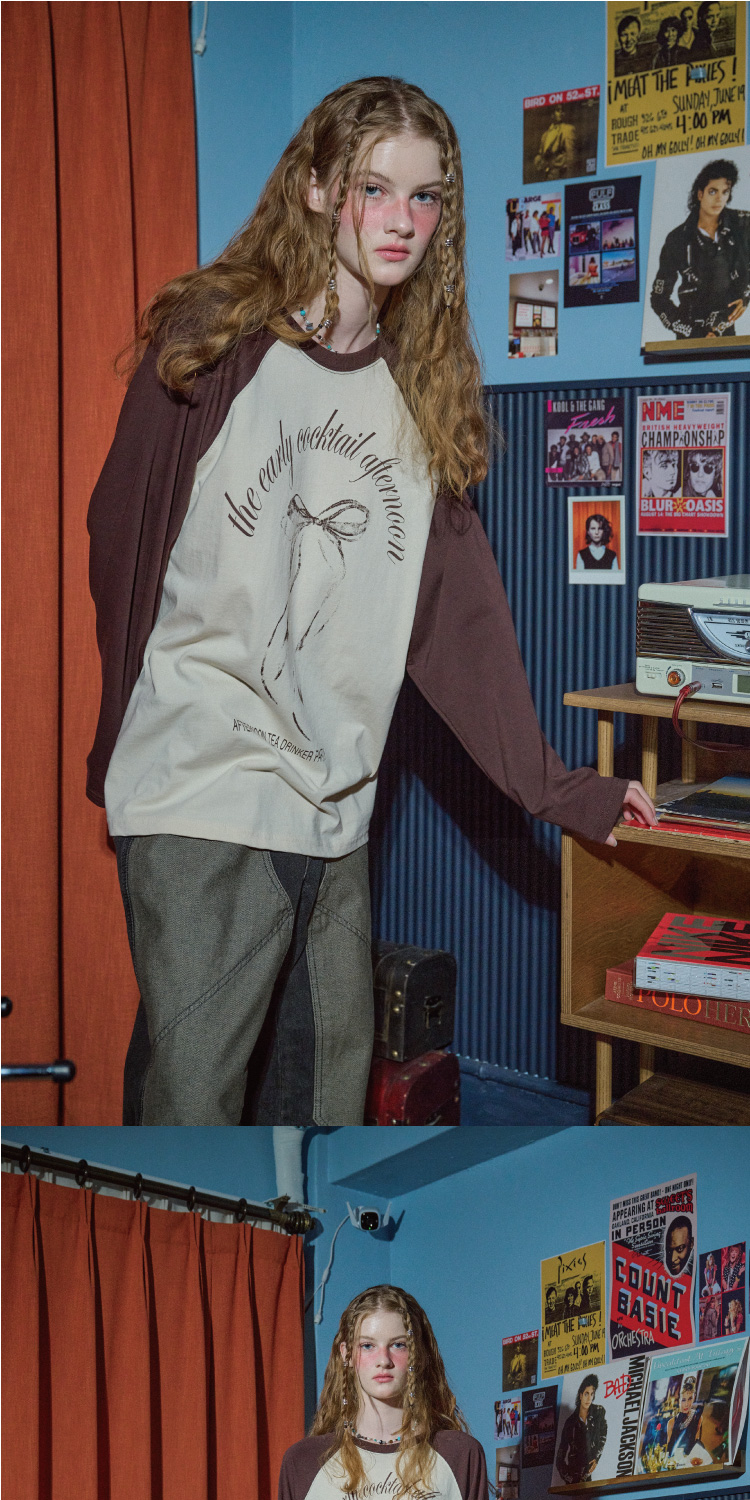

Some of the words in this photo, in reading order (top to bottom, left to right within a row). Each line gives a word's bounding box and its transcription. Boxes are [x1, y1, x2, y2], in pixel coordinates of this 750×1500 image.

[652, 67, 679, 93] THE
[524, 98, 546, 109] BIRD
[549, 94, 563, 104] ON
[713, 85, 737, 107] JUNE
[620, 103, 629, 114] AT
[612, 115, 639, 131] ROUGH
[676, 111, 708, 134] 4:00
[712, 108, 732, 125] PM
[612, 129, 640, 145] TRADE
[642, 143, 654, 159] OH
[655, 142, 667, 157] MY
[696, 136, 706, 150] OH
[708, 133, 719, 147] MY
[553, 401, 569, 413] KOOL
[576, 400, 588, 412] THE
[588, 399, 606, 412] GANG
[642, 400, 684, 421] NME
[224, 487, 263, 537] the
[258, 419, 295, 490] early
[296, 408, 377, 461] cocktail
[349, 452, 407, 565] afternoon
[640, 499, 674, 512] BLUR
[685, 499, 723, 512] OASIS
[267, 732, 281, 749] TEA
[280, 738, 314, 762] DRINKER
[612, 1202, 646, 1222] APPEARING
[646, 1199, 655, 1211] AT
[611, 1229, 622, 1241] IN
[626, 1215, 667, 1237] PERSON
[615, 1256, 687, 1310] COUNT
[561, 1318, 575, 1334] THE
[617, 1288, 682, 1341] BASIE
[590, 1343, 600, 1353] PM
[611, 1327, 655, 1350] ORCHESTRA
[603, 1373, 632, 1400] BAD
[623, 1354, 646, 1418] MICHAEL
[615, 1416, 639, 1478] JACKSON
